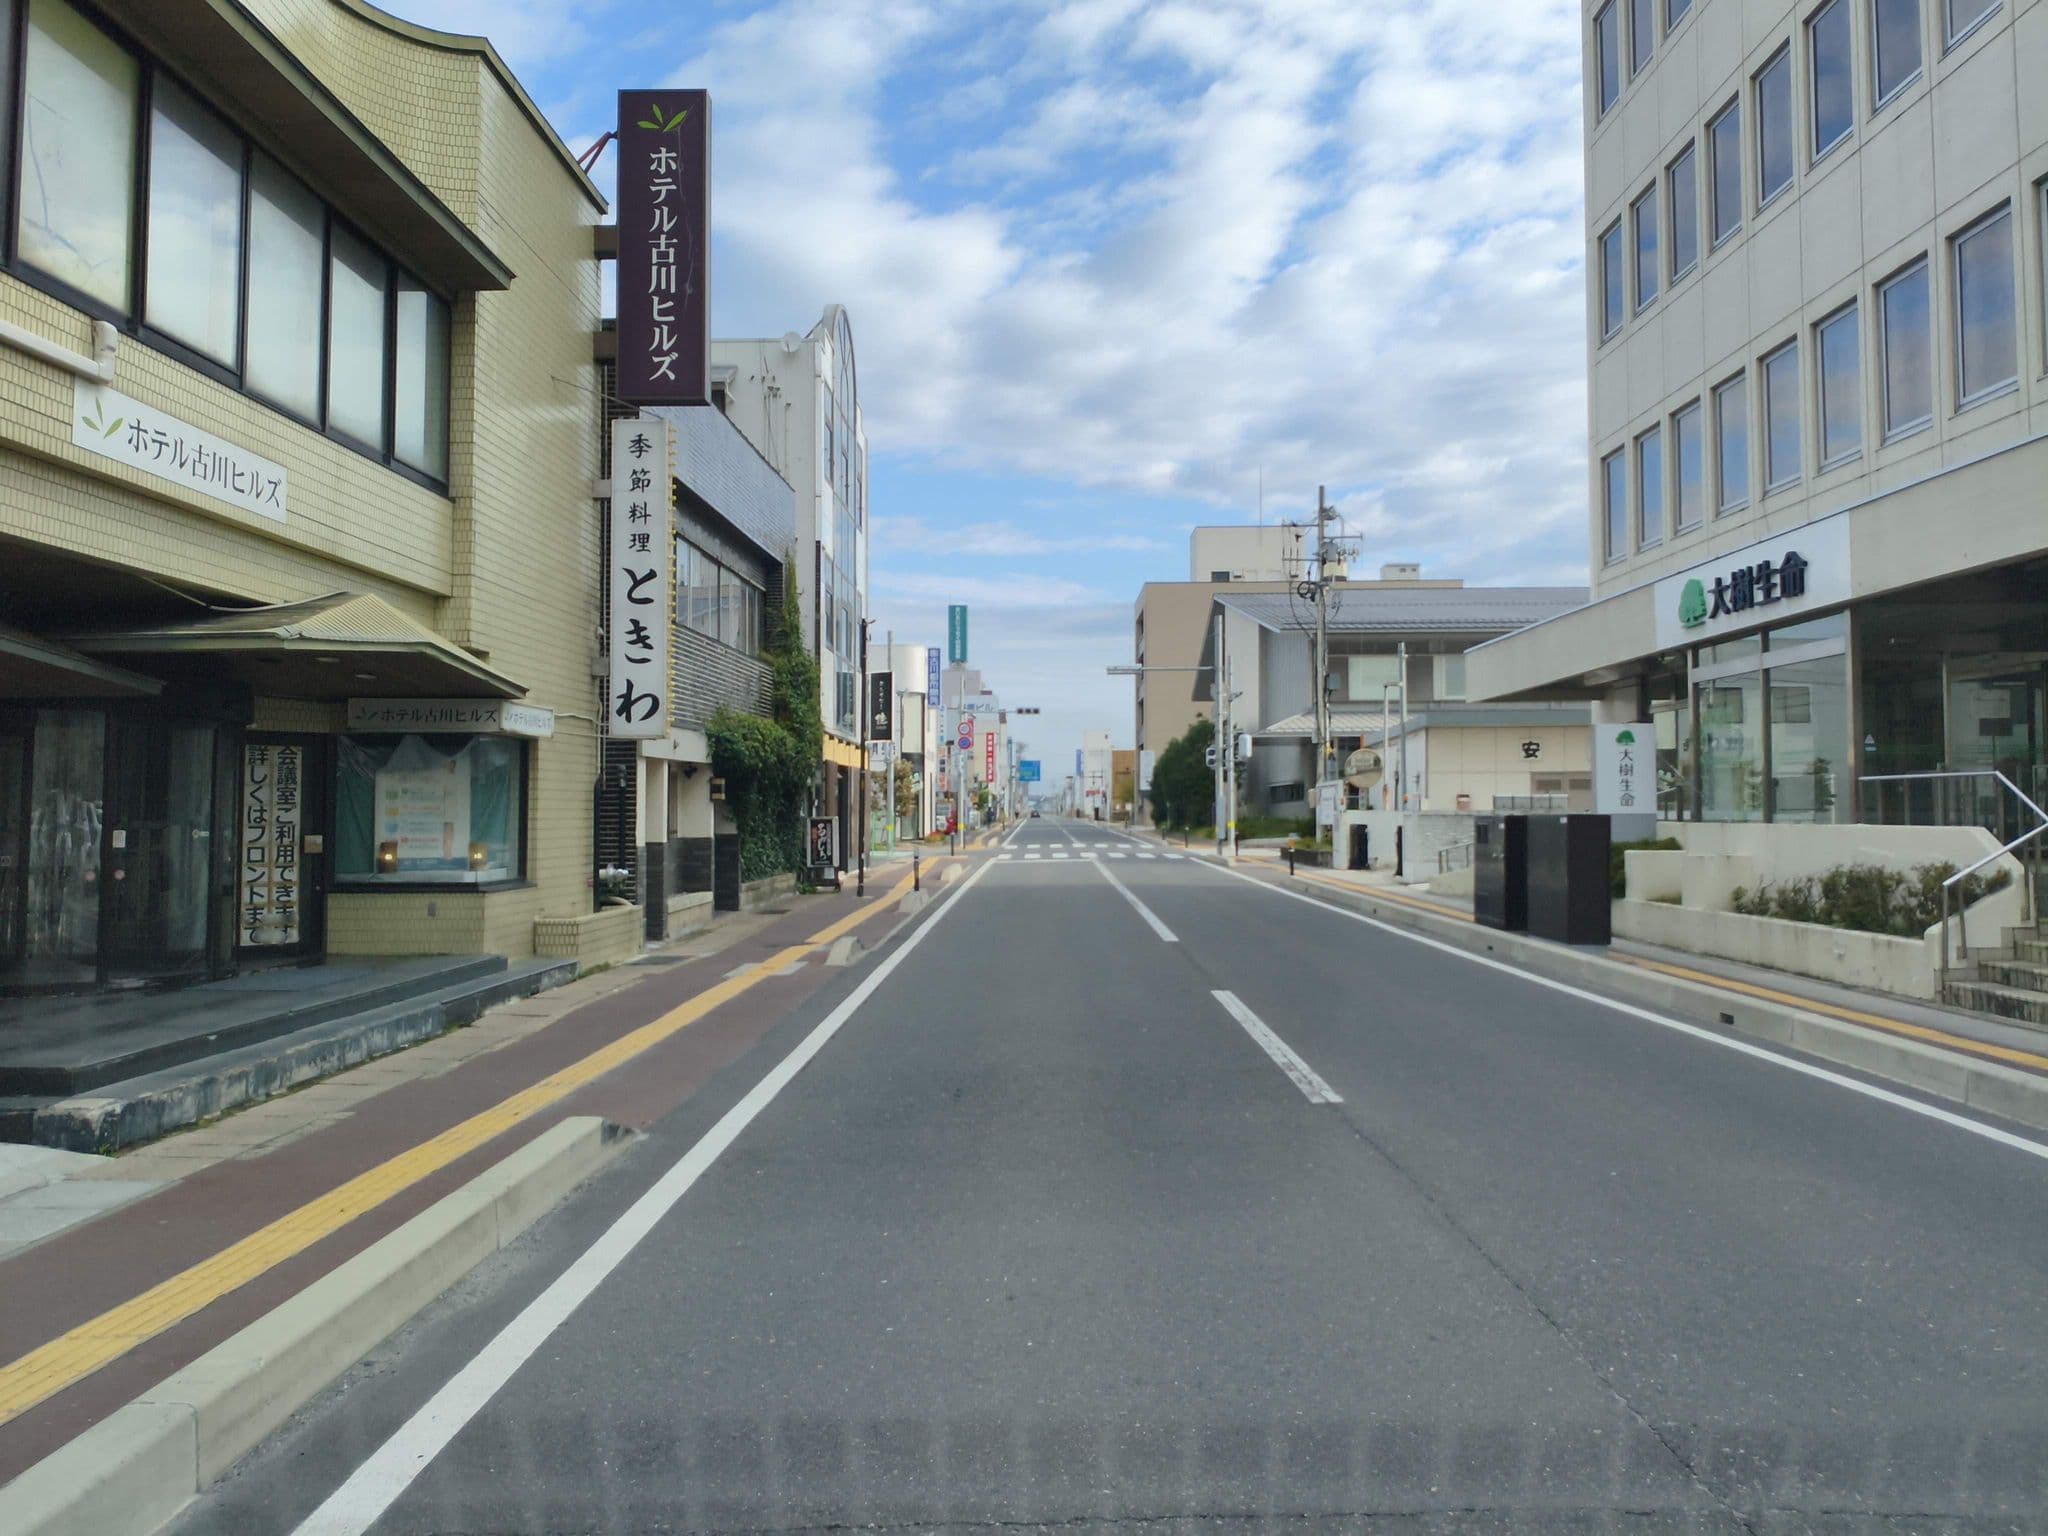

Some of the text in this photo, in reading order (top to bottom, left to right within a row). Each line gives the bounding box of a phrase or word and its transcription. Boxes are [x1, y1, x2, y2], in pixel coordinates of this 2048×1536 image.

[648, 147, 678, 381] ホテル古川ヒルズ
[128, 418, 282, 508] ホテル古川ヒルズ
[628, 433, 652, 552] 季節料理
[1707, 551, 1808, 619] 大樹生命
[615, 567, 660, 723] ときわ
[381, 708, 497, 723] ホテル古川ヒルズ
[1619, 749, 1635, 806] 大樹生命
